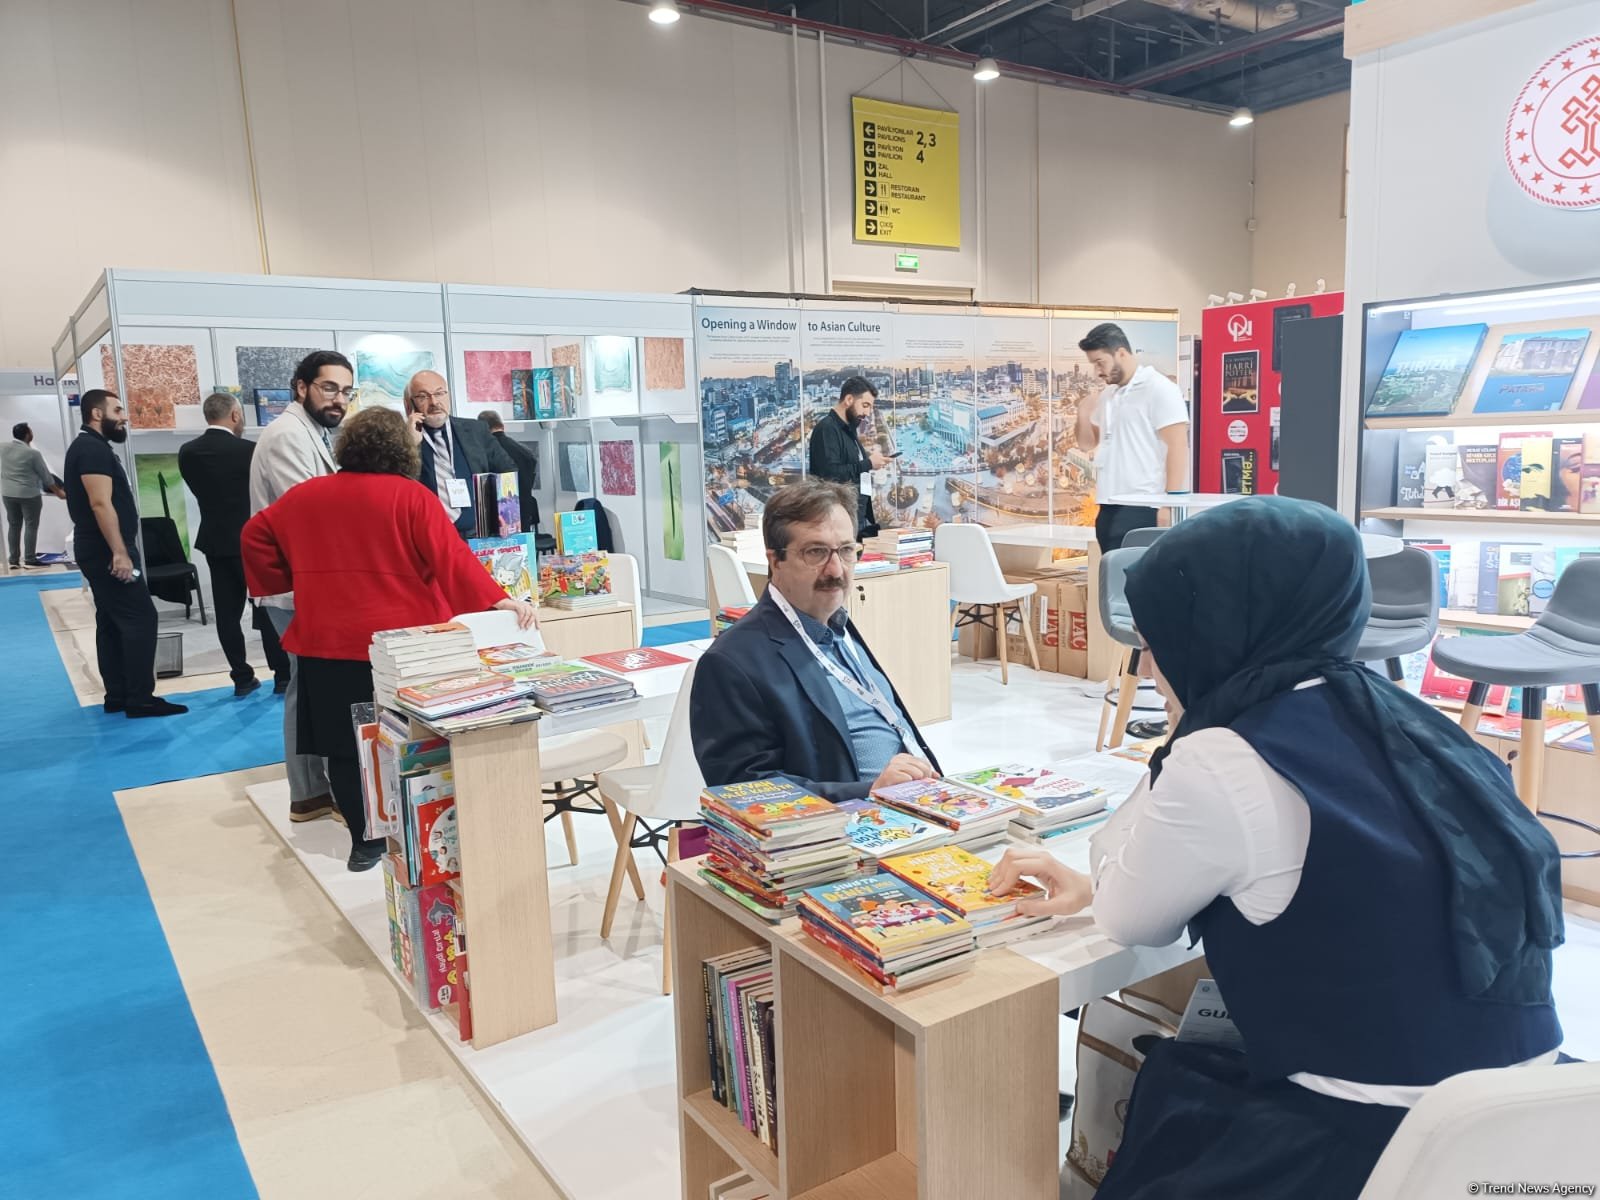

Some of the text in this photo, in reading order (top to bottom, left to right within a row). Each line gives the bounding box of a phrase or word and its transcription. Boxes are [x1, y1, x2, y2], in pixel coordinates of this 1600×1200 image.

[916, 149, 925, 164] 4
[878, 163, 889, 171] ZAL
[878, 171, 893, 179] HALL
[890, 184, 920, 193] RESTORAN
[891, 191, 926, 202] RESTAURANT
[891, 207, 901, 215] WC
[701, 317, 881, 333] Opening a Window to Asian Culture
[1197, 1008, 1230, 1020] GU
